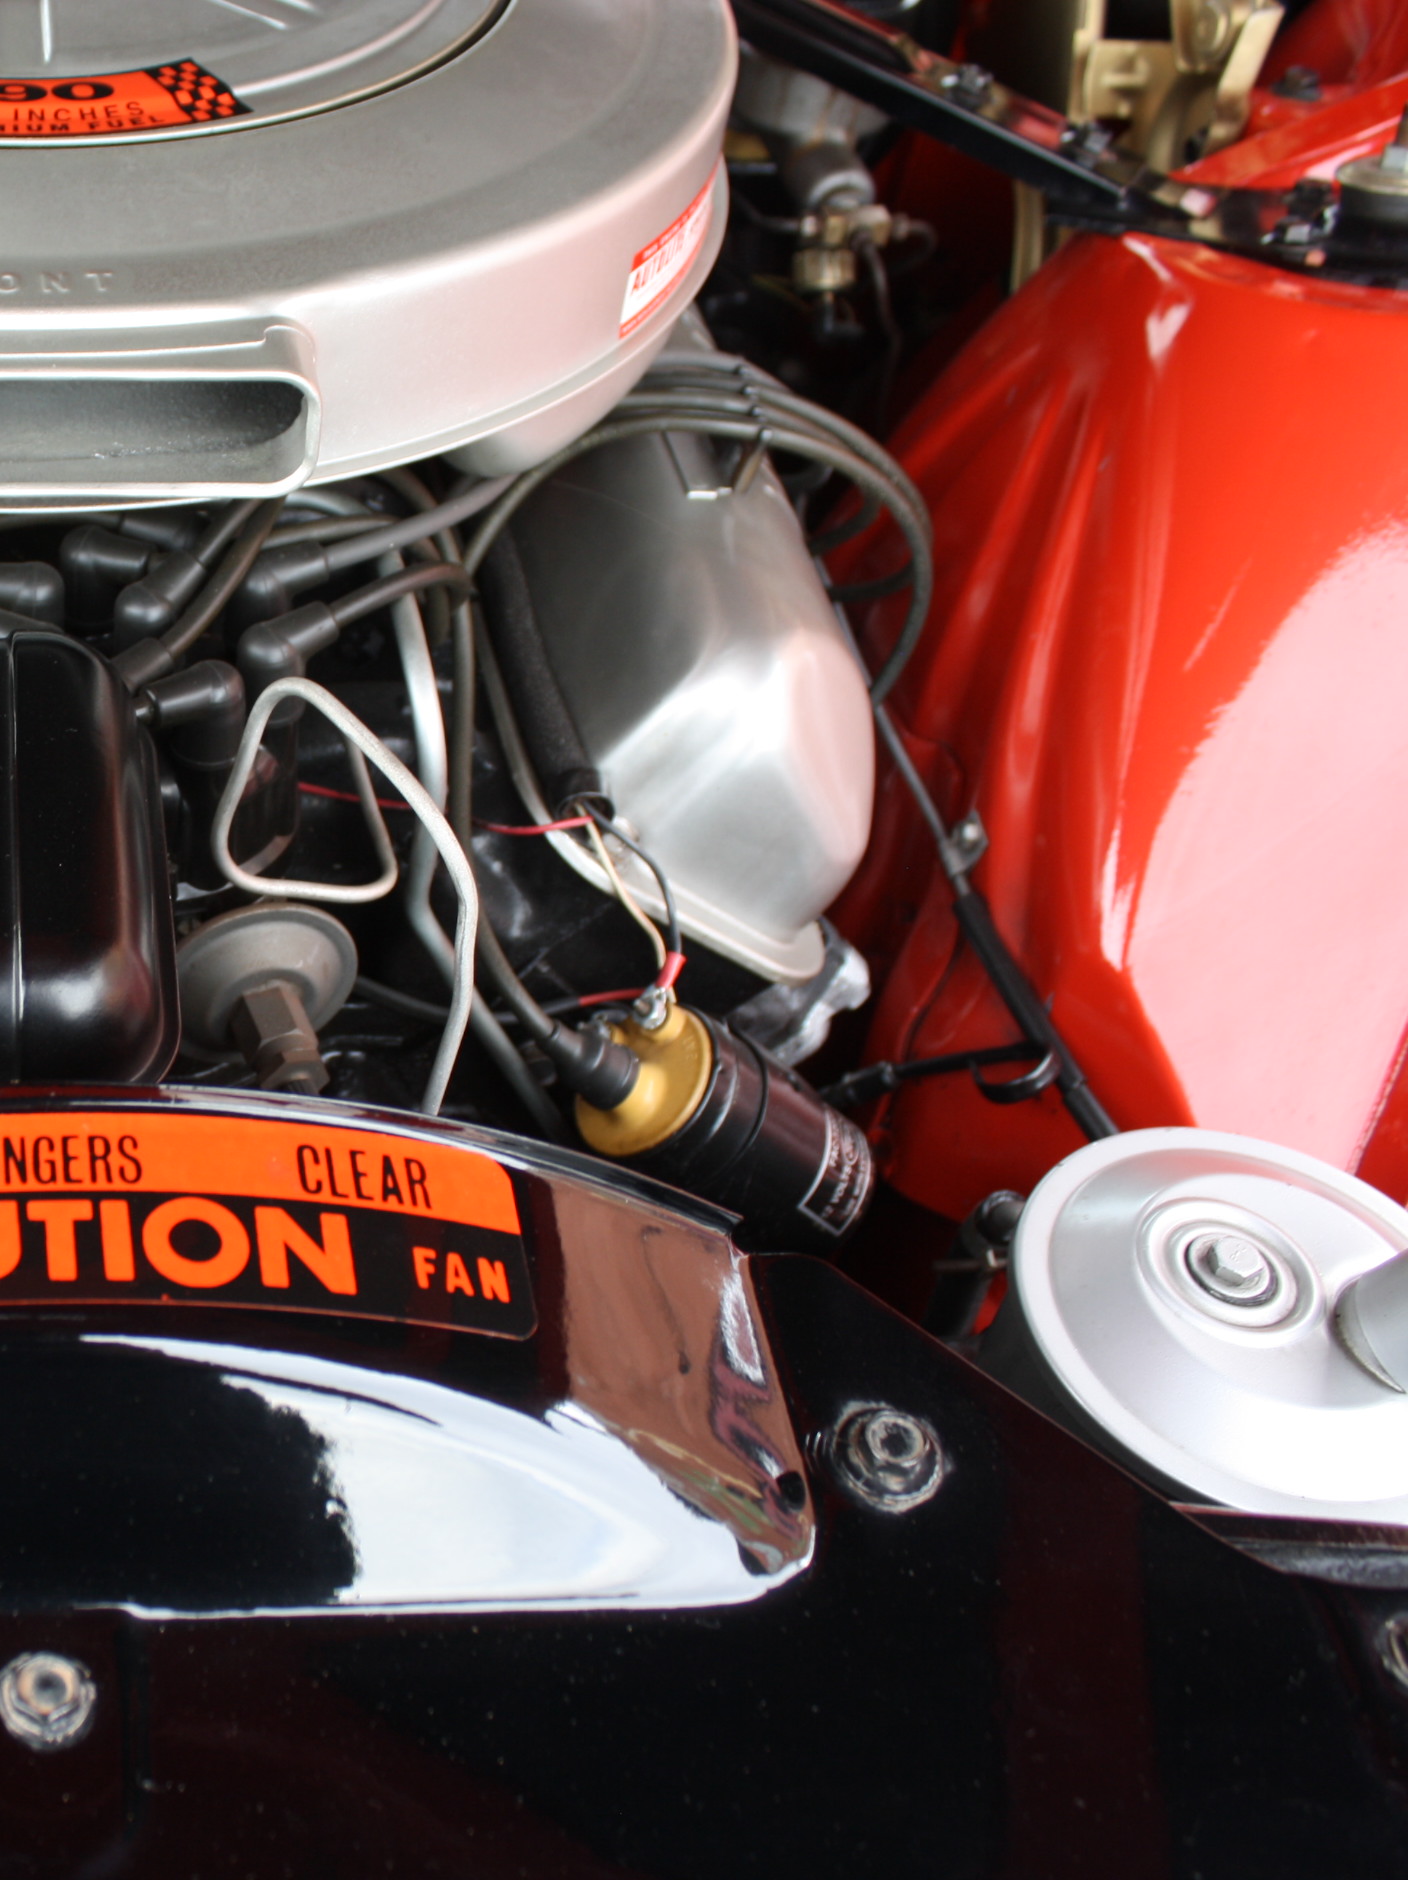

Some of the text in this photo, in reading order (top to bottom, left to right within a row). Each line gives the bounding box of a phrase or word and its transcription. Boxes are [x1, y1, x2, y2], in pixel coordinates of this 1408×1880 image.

[14, 102, 145, 122] INCHES
[88, 115, 166, 130] FUEL
[295, 1144, 433, 1209] CLEAR
[413, 1246, 511, 1303] FAN
